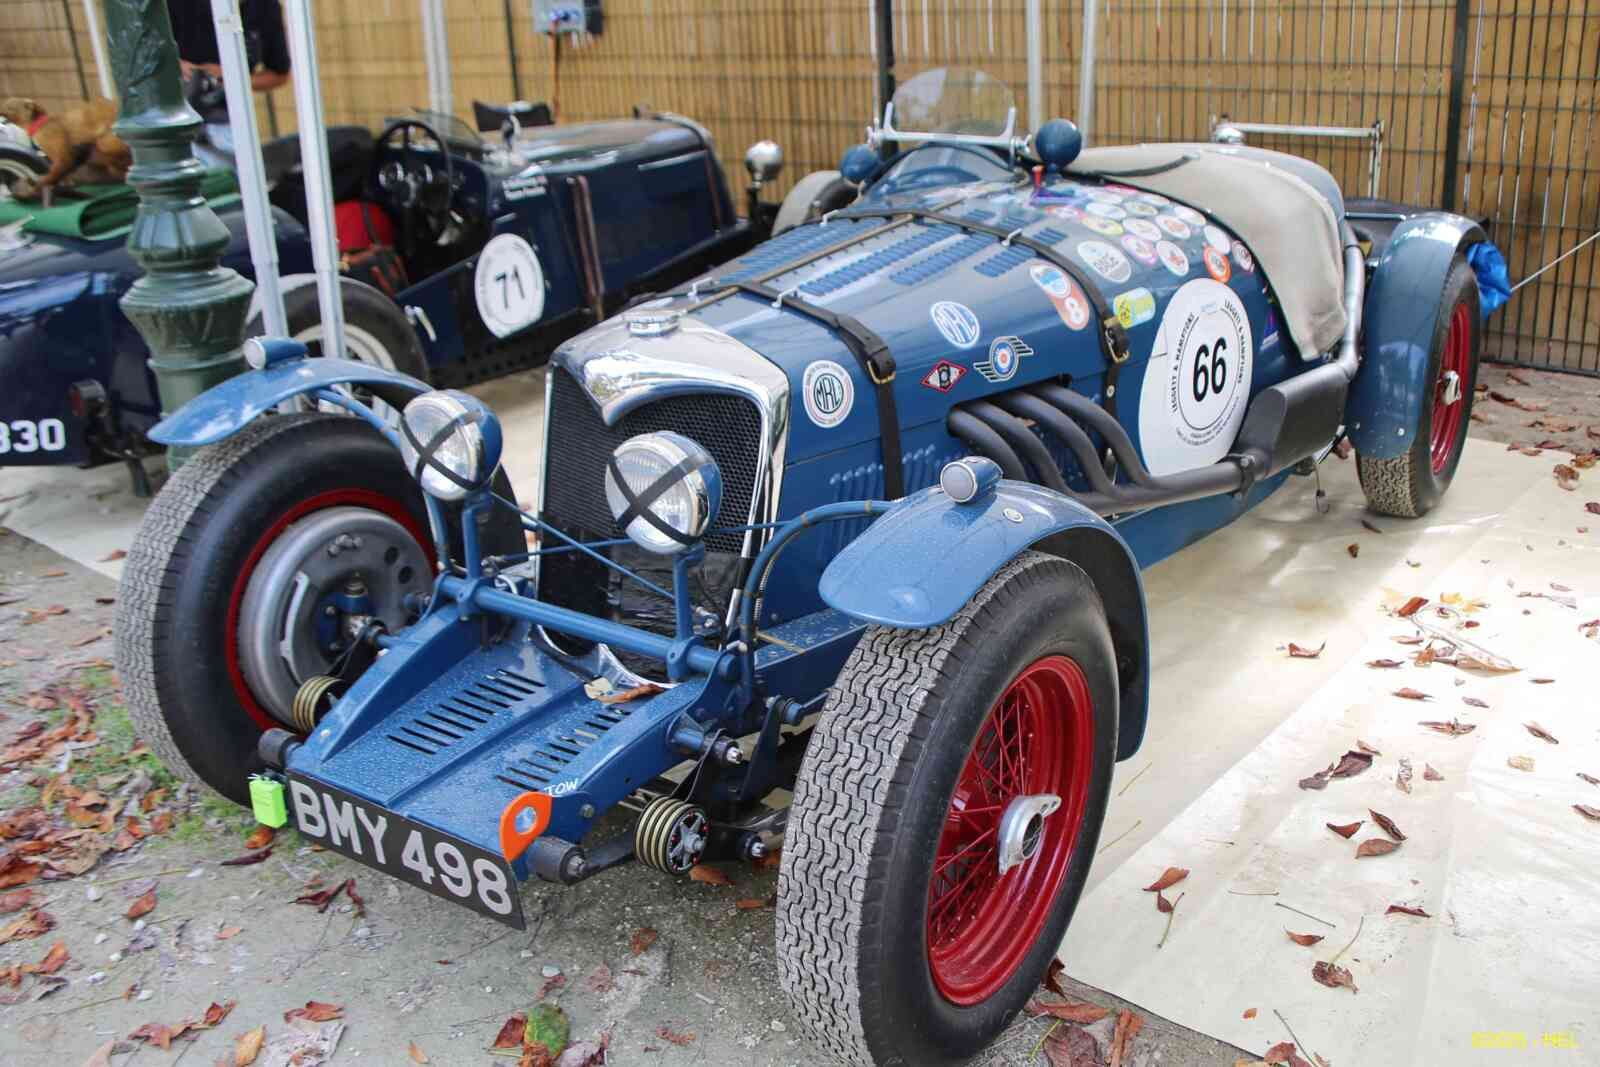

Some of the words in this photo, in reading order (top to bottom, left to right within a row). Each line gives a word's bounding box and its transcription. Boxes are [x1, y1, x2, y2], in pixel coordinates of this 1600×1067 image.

[494, 263, 526, 310] 71
[1192, 336, 1228, 403] 66
[543, 777, 579, 796] TOW
[289, 779, 388, 865] BMY
[400, 829, 514, 915] 498
